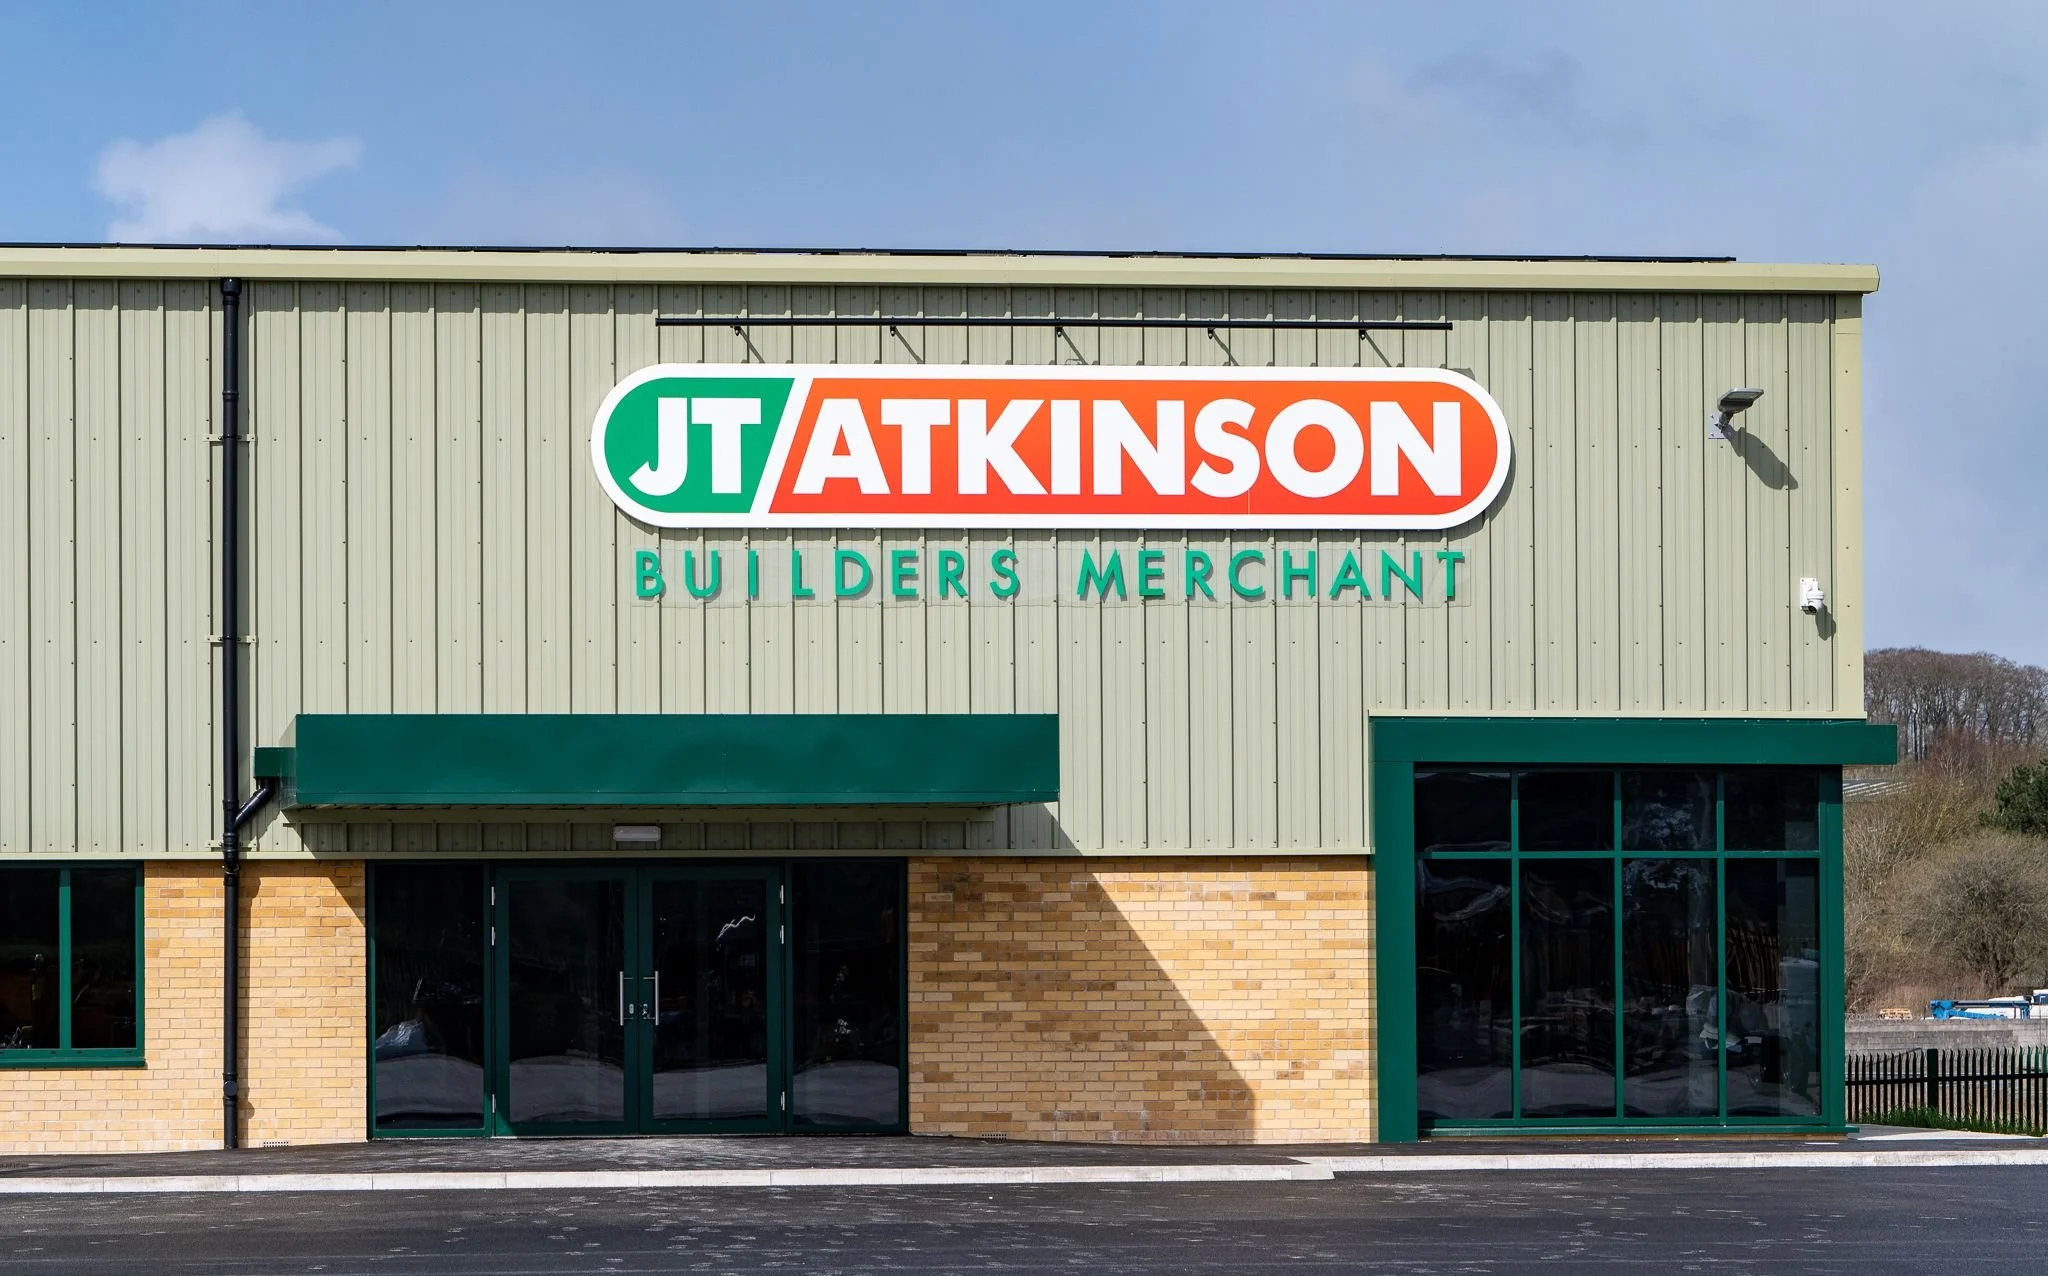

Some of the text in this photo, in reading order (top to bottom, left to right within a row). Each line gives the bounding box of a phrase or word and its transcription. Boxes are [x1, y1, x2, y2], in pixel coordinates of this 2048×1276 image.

[629, 397, 1461, 498] JT ATKINSON
[635, 549, 1466, 600] BUILDERS MERCHANT
